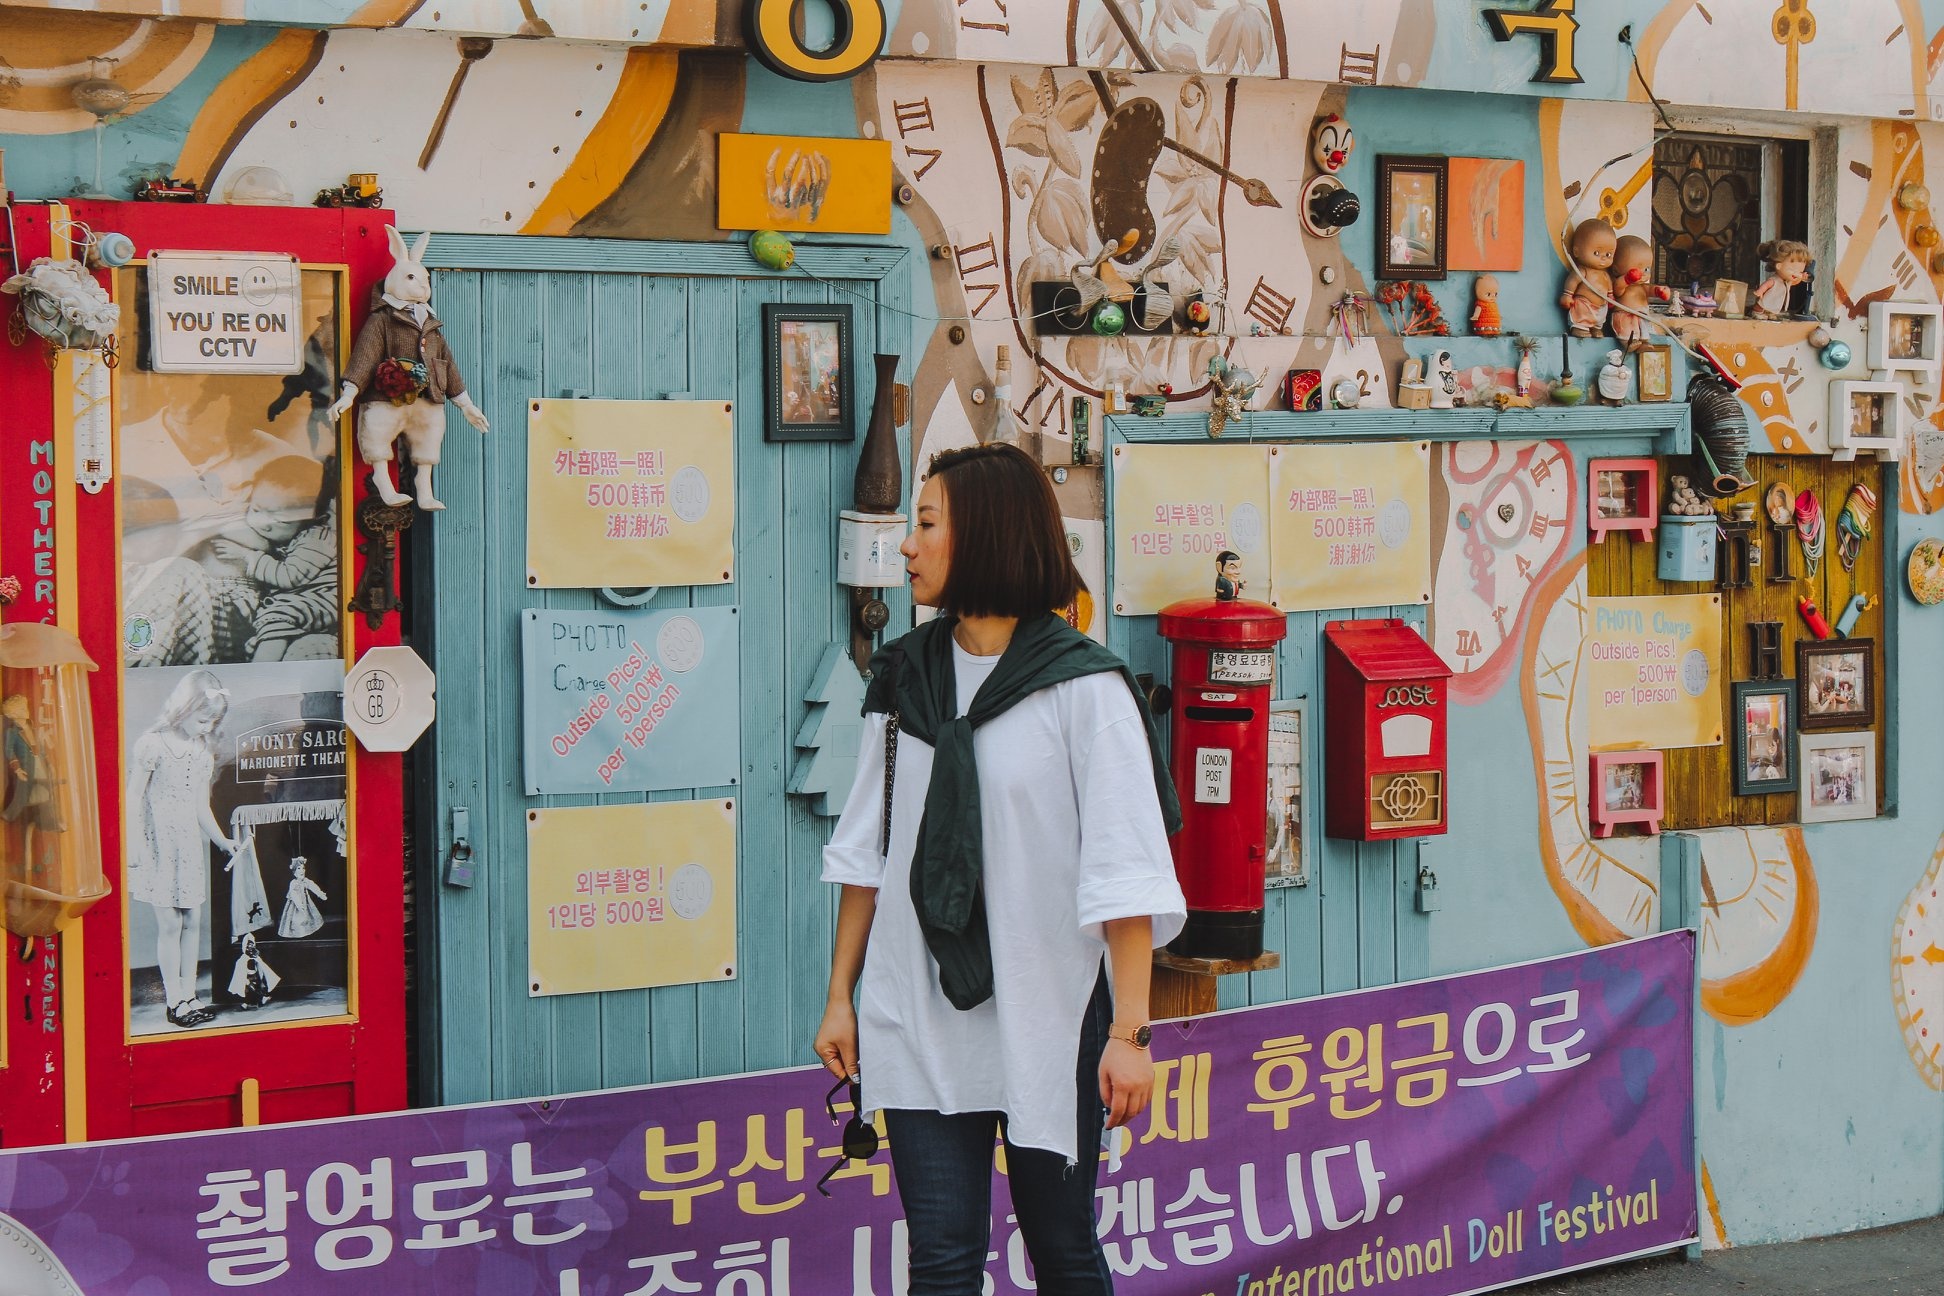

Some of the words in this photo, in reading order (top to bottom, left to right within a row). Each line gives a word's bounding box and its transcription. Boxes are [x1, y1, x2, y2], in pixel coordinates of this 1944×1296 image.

[173, 275, 239, 296] SMILE
[222, 313, 251, 332] RE
[255, 313, 287, 333] ON
[199, 337, 257, 358] CCTV
[587, 482, 665, 509] 500韩币
[1154, 503, 1215, 527] 외부촬영
[1313, 516, 1376, 538] 500韩币
[1130, 532, 1174, 556] 1인당
[1181, 531, 1228, 554] 500원
[1595, 606, 1644, 635] PHOTO
[1591, 641, 1640, 660] Outside
[1645, 639, 1676, 659] Pics!
[367, 695, 384, 718] GB
[552, 693, 610, 757] Outside
[606, 640, 650, 693] Pics!
[1604, 689, 1626, 707] per
[1630, 685, 1678, 706] 1person
[250, 732, 297, 752] TONY
[597, 747, 627, 785] per
[624, 683, 680, 748] 1person
[240, 753, 307, 771] MARIONETTE
[1201, 754, 1228, 767] LONDON
[1205, 770, 1222, 782] POST
[1207, 786, 1220, 797] 7PM
[576, 867, 650, 896] 외부촬영
[548, 902, 597, 929] 1인당
[605, 897, 664, 925] 500원
[196, 1140, 595, 1288] 촬영료는
[1246, 989, 1592, 1131] 후원금으로
[1236, 1224, 1453, 1296] International
[1467, 1209, 1524, 1264] Doll
[1537, 1178, 1659, 1246] Festival
